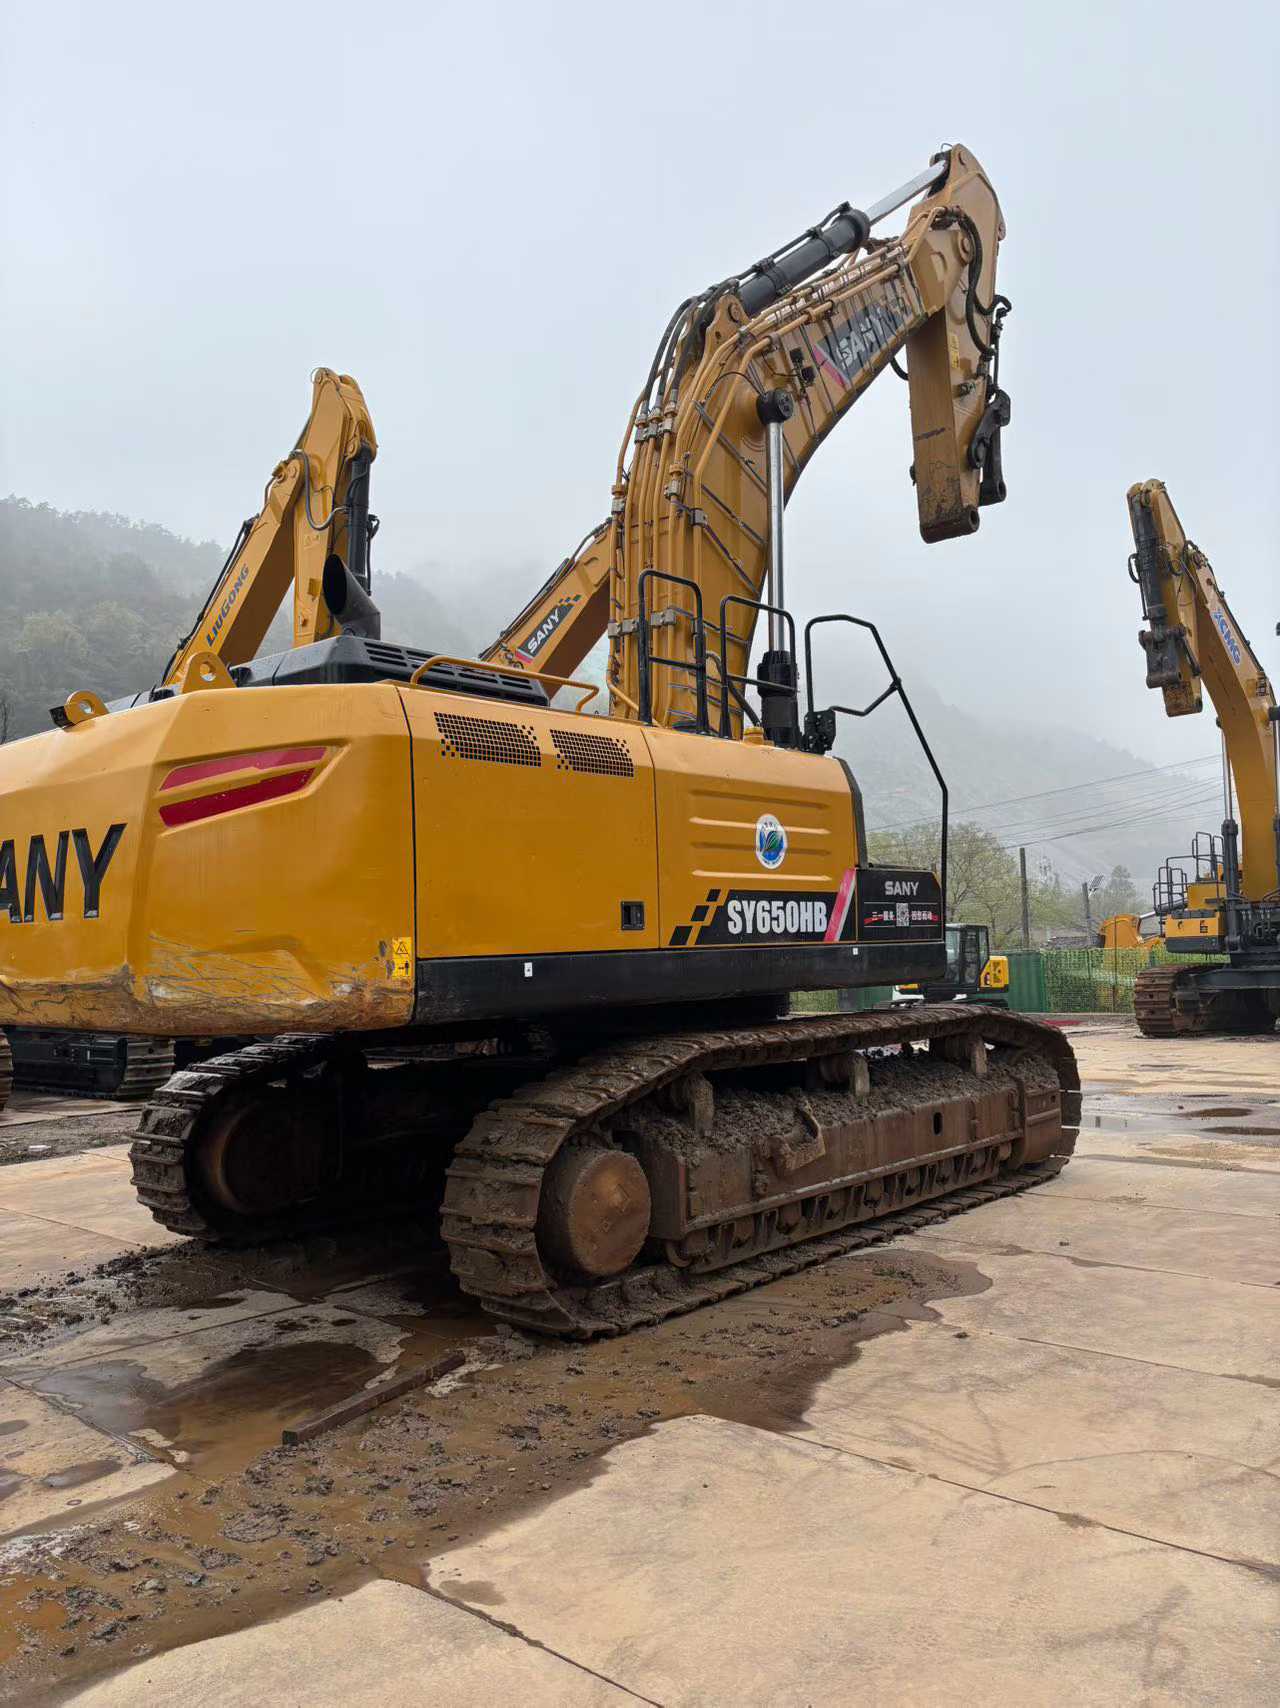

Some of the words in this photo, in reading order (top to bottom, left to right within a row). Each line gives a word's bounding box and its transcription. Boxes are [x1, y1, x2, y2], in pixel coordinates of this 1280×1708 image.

[206, 563, 250, 647] LIUGONG
[527, 607, 560, 654] SANY
[884, 880, 919, 896] SANY
[727, 899, 828, 935] SY650HB
